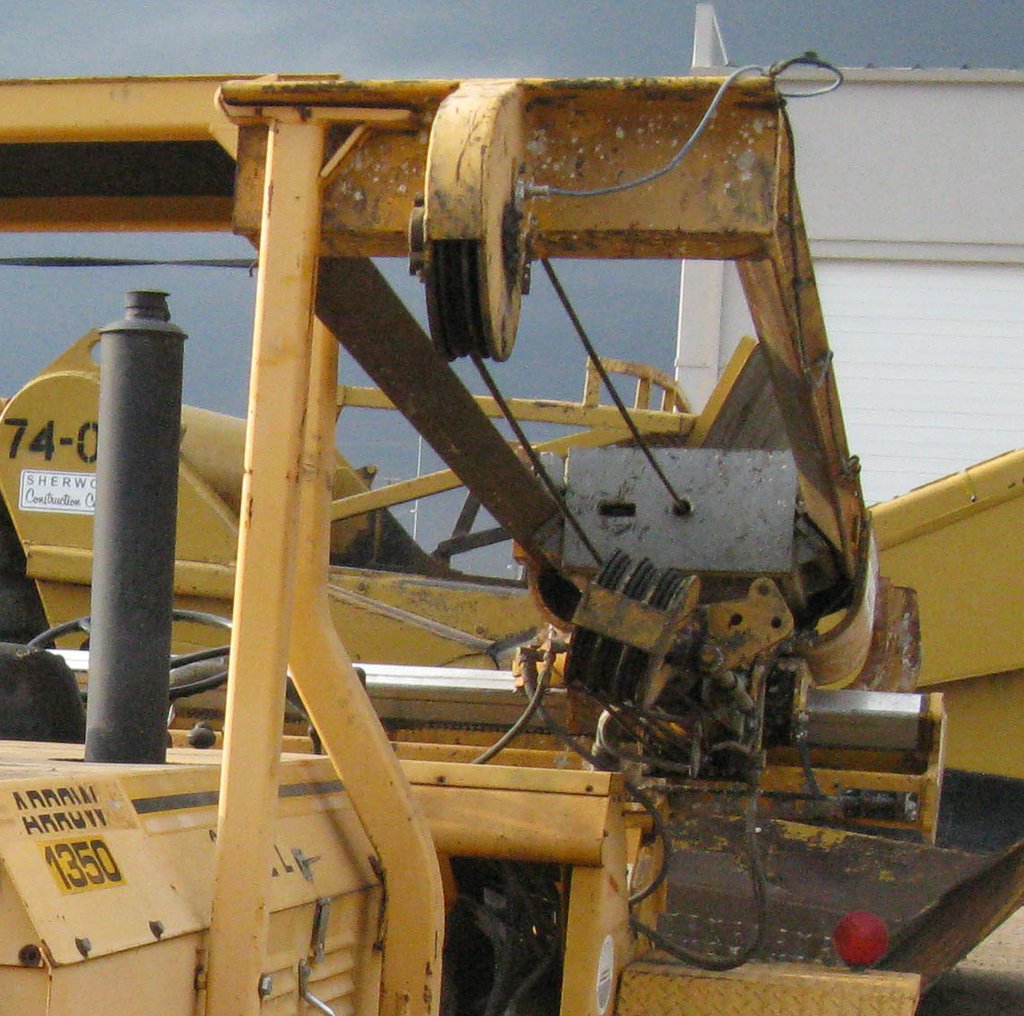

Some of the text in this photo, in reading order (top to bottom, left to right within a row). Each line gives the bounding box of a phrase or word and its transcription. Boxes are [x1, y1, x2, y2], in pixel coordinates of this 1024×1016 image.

[25, 488, 81, 506] Construction
[12, 784, 108, 835] ARROW
[44, 839, 122, 890] 1350
